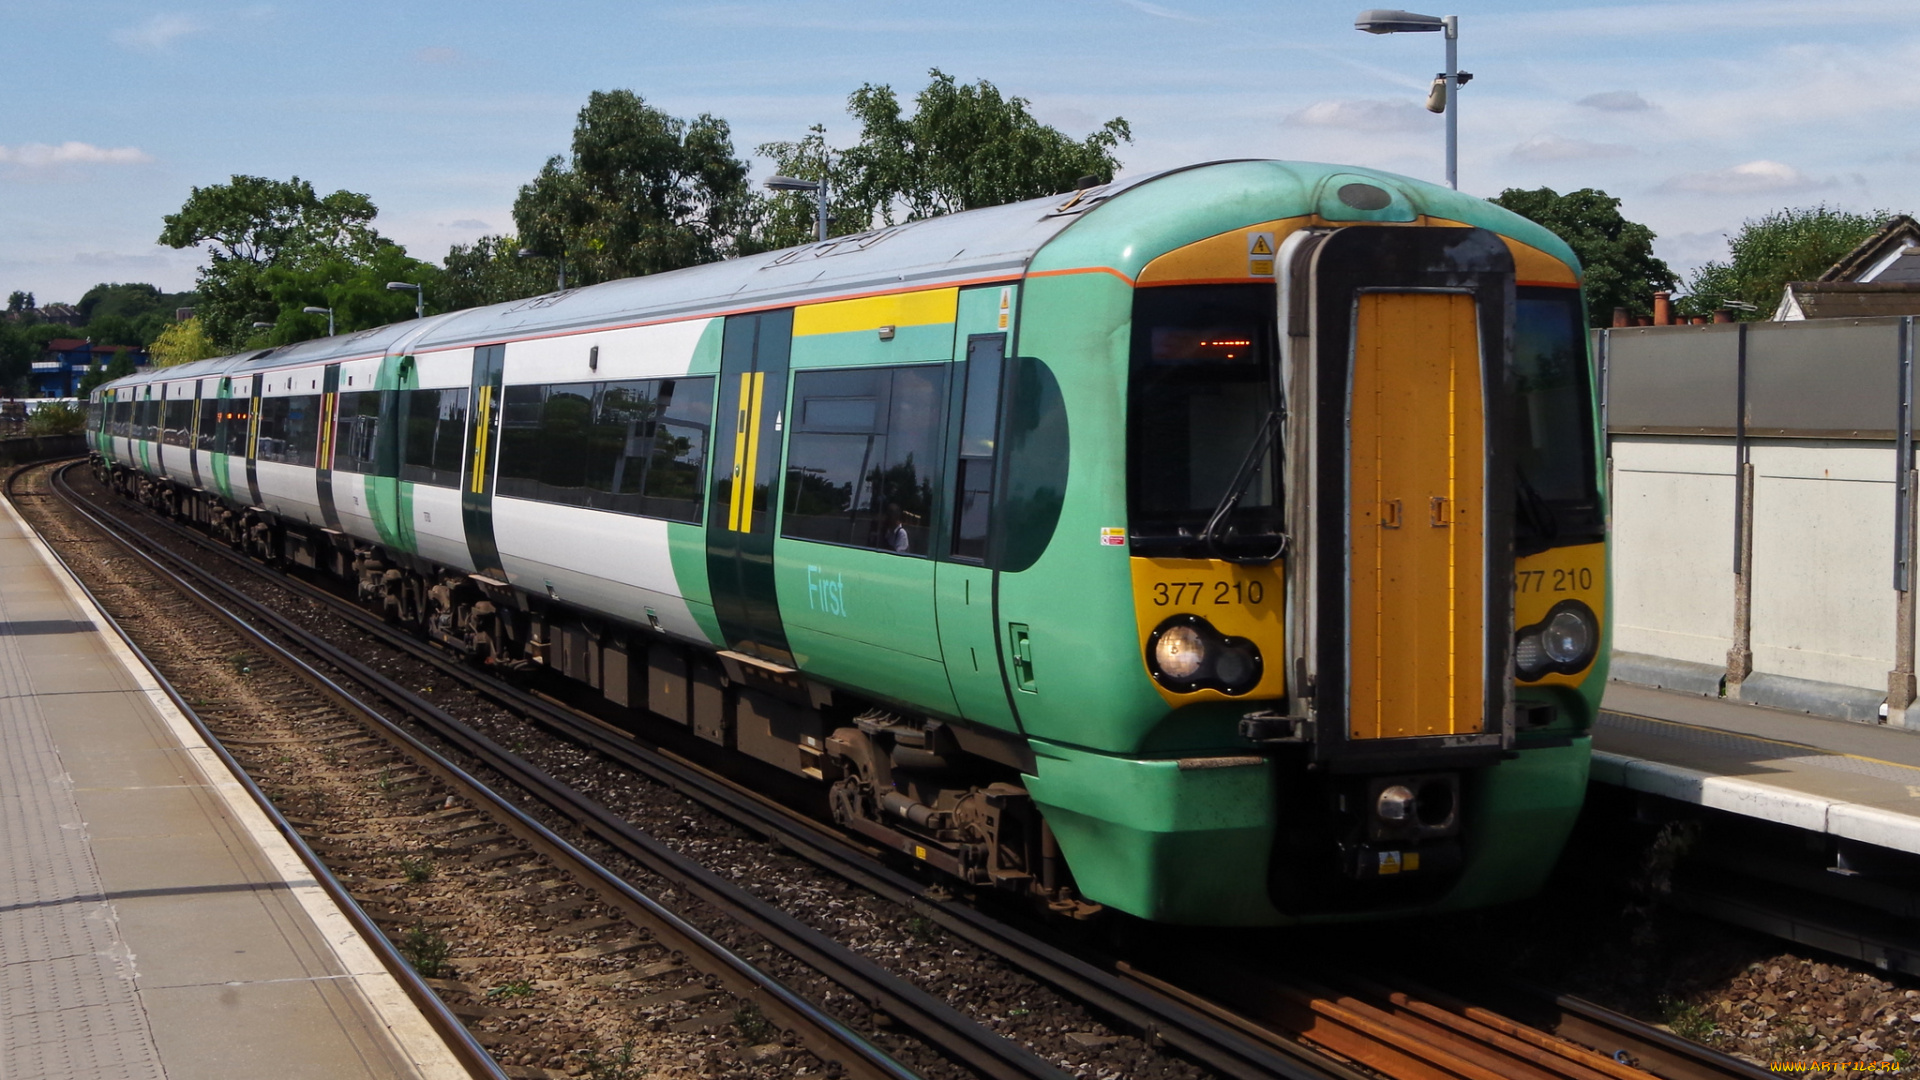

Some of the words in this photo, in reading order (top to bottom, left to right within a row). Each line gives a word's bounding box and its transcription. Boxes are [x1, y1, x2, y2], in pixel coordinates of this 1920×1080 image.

[807, 564, 847, 618] First
[1153, 582, 1204, 606] 377
[1214, 580, 1264, 604] 210
[1514, 570, 1546, 593] 77
[1553, 567, 1592, 592] 210
